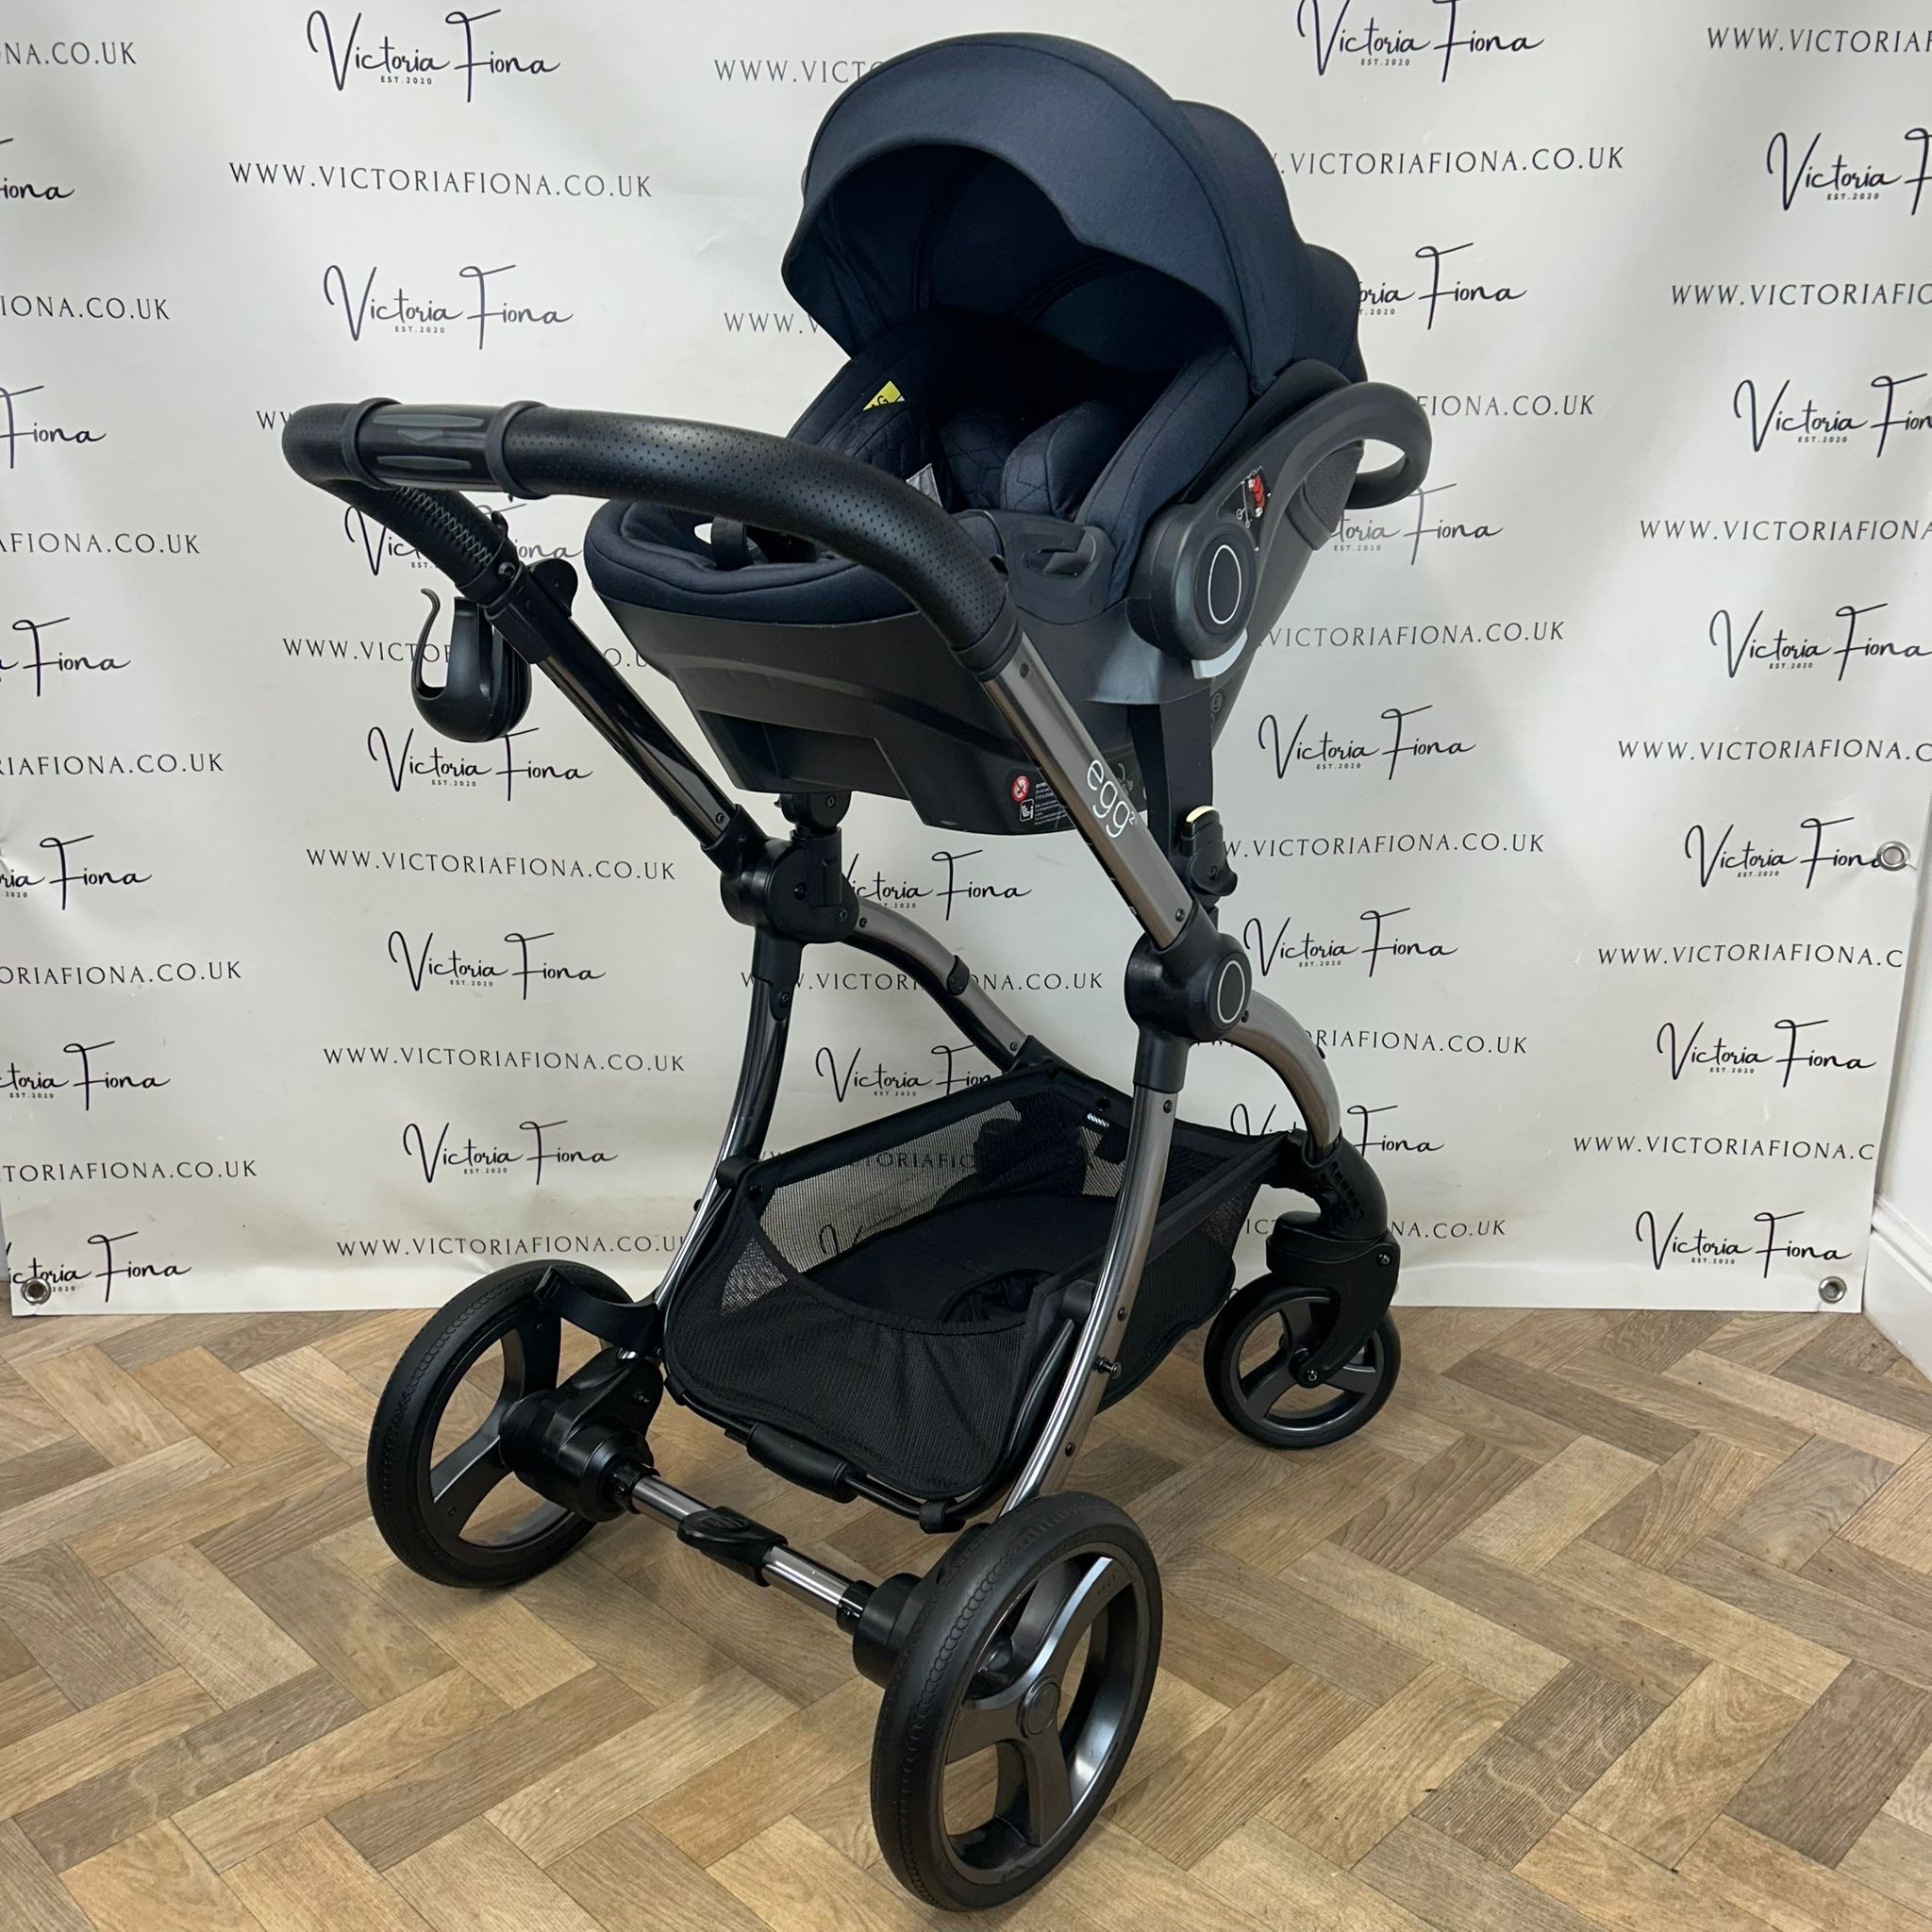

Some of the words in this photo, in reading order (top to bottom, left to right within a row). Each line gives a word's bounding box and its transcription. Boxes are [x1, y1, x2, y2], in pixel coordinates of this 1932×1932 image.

[307, 10, 451, 92] Victoria
[445, 9, 560, 103] Fiona
[1297, 0, 1431, 76] Victoria
[1432, 0, 1545, 83] Fiona
[229, 162, 652, 197] WWW.VICTORIAFIONA.CO.UK
[1272, 146, 1624, 174] .VICTORIAFIONA.CO.UK
[1766, 132, 1902, 211] Victoria
[324, 265, 463, 341] Victoria
[459, 265, 574, 350] Fiona
[1415, 242, 1527, 330] Fiona
[1733, 379, 1869, 452] Victoria
[1870, 373, 1932, 458] Fion
[1331, 519, 1401, 540] toria
[12, 617, 131, 697] Fiona
[1269, 622, 1565, 646] VICTORIAFIONA.CO.UK
[1709, 609, 1832, 678] Victoria
[1832, 603, 1932, 681] Fiona
[367, 726, 492, 791] Victoria
[495, 728, 594, 801] Fiona
[1258, 714, 1380, 779] Victoria
[1381, 705, 1476, 780] Fiona
[1618, 740, 1932, 762] WWW.VICTORIAFIONA.C
[39, 835, 153, 910] Fiona
[306, 849, 676, 880] WWW.VICTORIAFIONA.CO.UK
[1224, 833, 1544, 858] W.VICTORIAFIONA.CO.UK
[1685, 824, 1798, 888] Victoria
[931, 849, 1032, 921] Fiona
[0, 961, 242, 984] ORIAFIONA.CO.UK
[388, 931, 508, 991] Victoria
[504, 932, 606, 1000] Fiona
[1243, 917, 1359, 977] Victoria
[1359, 908, 1458, 977] Fiona
[1598, 944, 1903, 967] WWW.VICTORIAFIONA.C
[0, 1062, 70, 1091] toria
[63, 1041, 171, 1111] Fiona
[324, 1047, 684, 1072] WWW.VICTORIAFIONA.CO.UK
[815, 1047, 933, 1102] Victoria
[931, 1044, 991, 1094] Fion
[1657, 1022, 1774, 1080] Victoria
[1774, 1019, 1877, 1088] Fiona
[403, 1123, 524, 1183] Victoria
[519, 1120, 618, 1185] Fiona
[1347, 1105, 1445, 1157] Fiona
[1574, 1136, 1875, 1159] WWW.VICTORIAFIONA.C
[2, 1160, 257, 1182] TORIAFIONA.CO.UK
[6, 1242, 92, 1284] ictoria
[87, 1231, 192, 1303] Fiona
[1636, 1210, 1754, 1270] Victoria
[1754, 1211, 1853, 1278] Fiona
